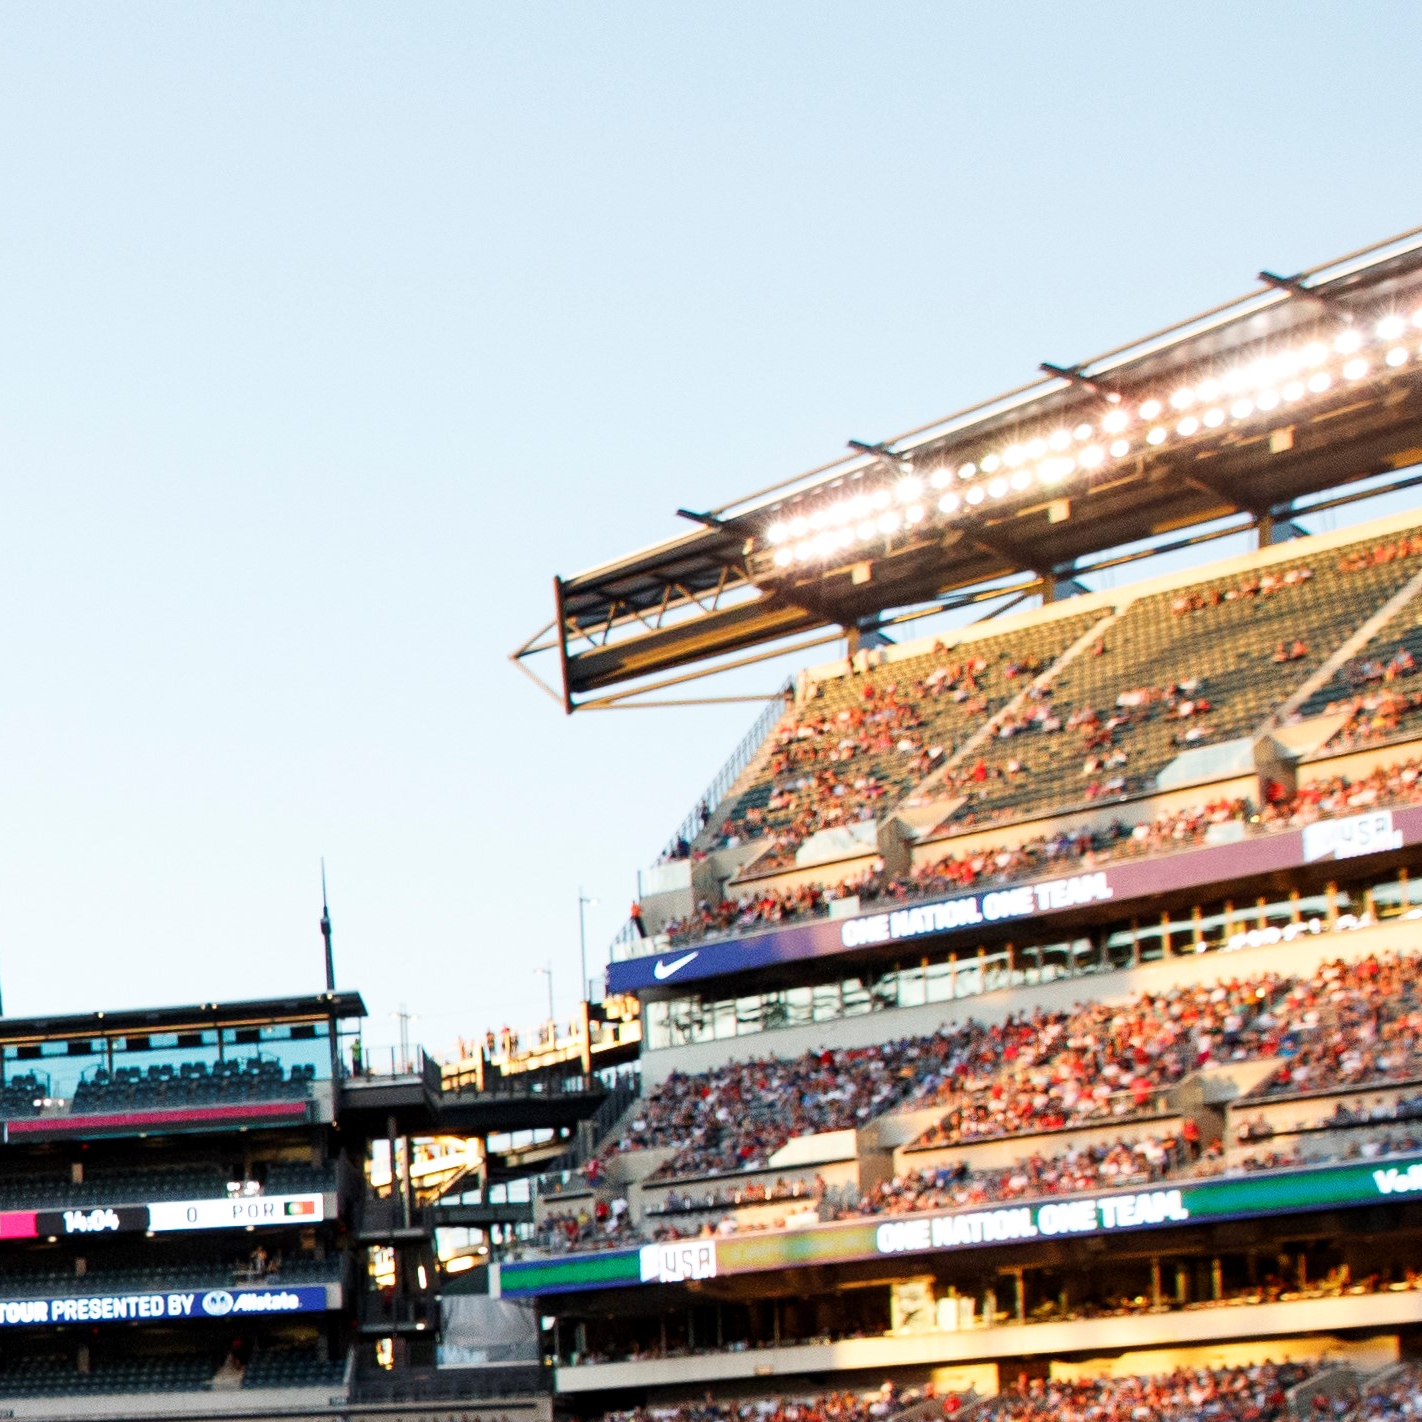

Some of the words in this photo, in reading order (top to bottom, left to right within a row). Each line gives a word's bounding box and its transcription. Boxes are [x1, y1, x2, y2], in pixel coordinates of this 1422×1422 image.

[841, 914, 890, 948] ONE
[890, 896, 983, 939] NATION.
[982, 885, 1034, 922] ONE
[1034, 871, 1113, 911] TEAM.
[63, 1210, 120, 1233] 14:04
[186, 1206, 198, 1224] 0
[232, 1202, 274, 1220] POR
[877, 1219, 931, 1254] ONE
[931, 1207, 1039, 1246] NATION.
[1039, 1201, 1098, 1238] ONE
[1097, 1189, 1189, 1230] TEAM.
[663, 1245, 712, 1274] USA
[51, 1296, 165, 1321] PRESENTED
[167, 1294, 194, 1315] BY
[232, 1291, 300, 1312] Allstate
